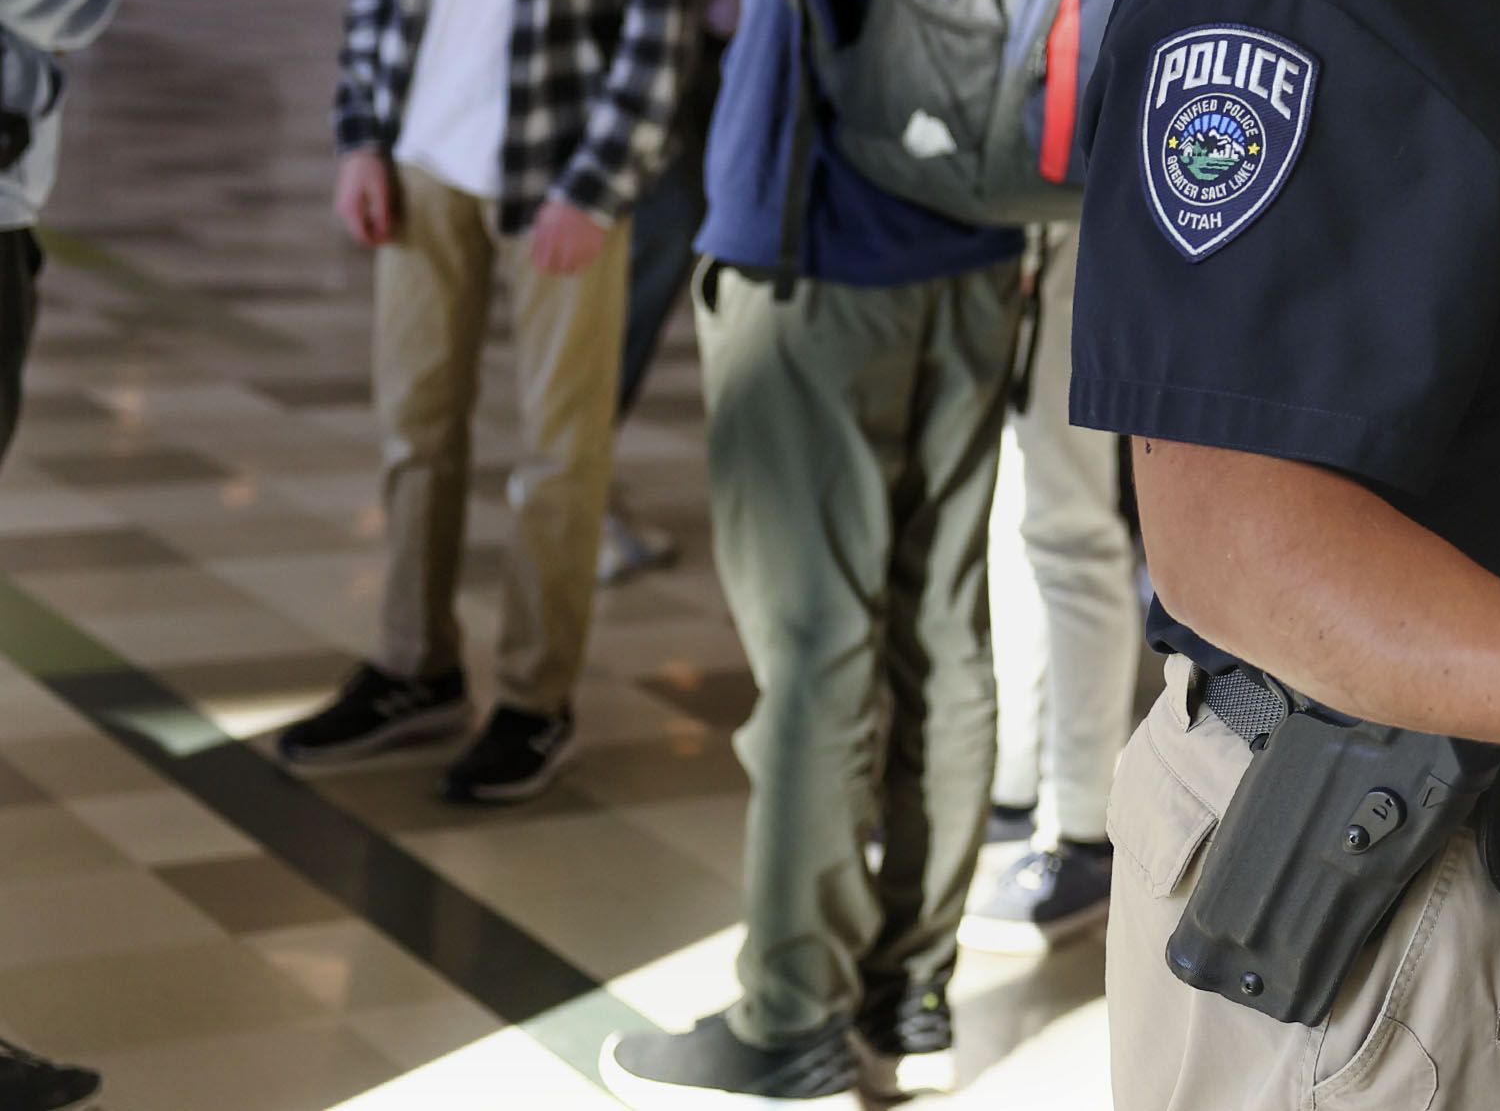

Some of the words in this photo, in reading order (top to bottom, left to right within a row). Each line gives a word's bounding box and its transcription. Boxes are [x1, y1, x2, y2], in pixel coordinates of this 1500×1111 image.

[1155, 40, 1299, 120] POLICE
[1174, 99, 1218, 131] UNIFIED
[1222, 101, 1259, 137] POLICE
[1167, 155, 1199, 199] GREATER
[1201, 183, 1227, 200] SALT
[1228, 160, 1255, 190] LAKE
[1177, 210, 1222, 230] UTAH
